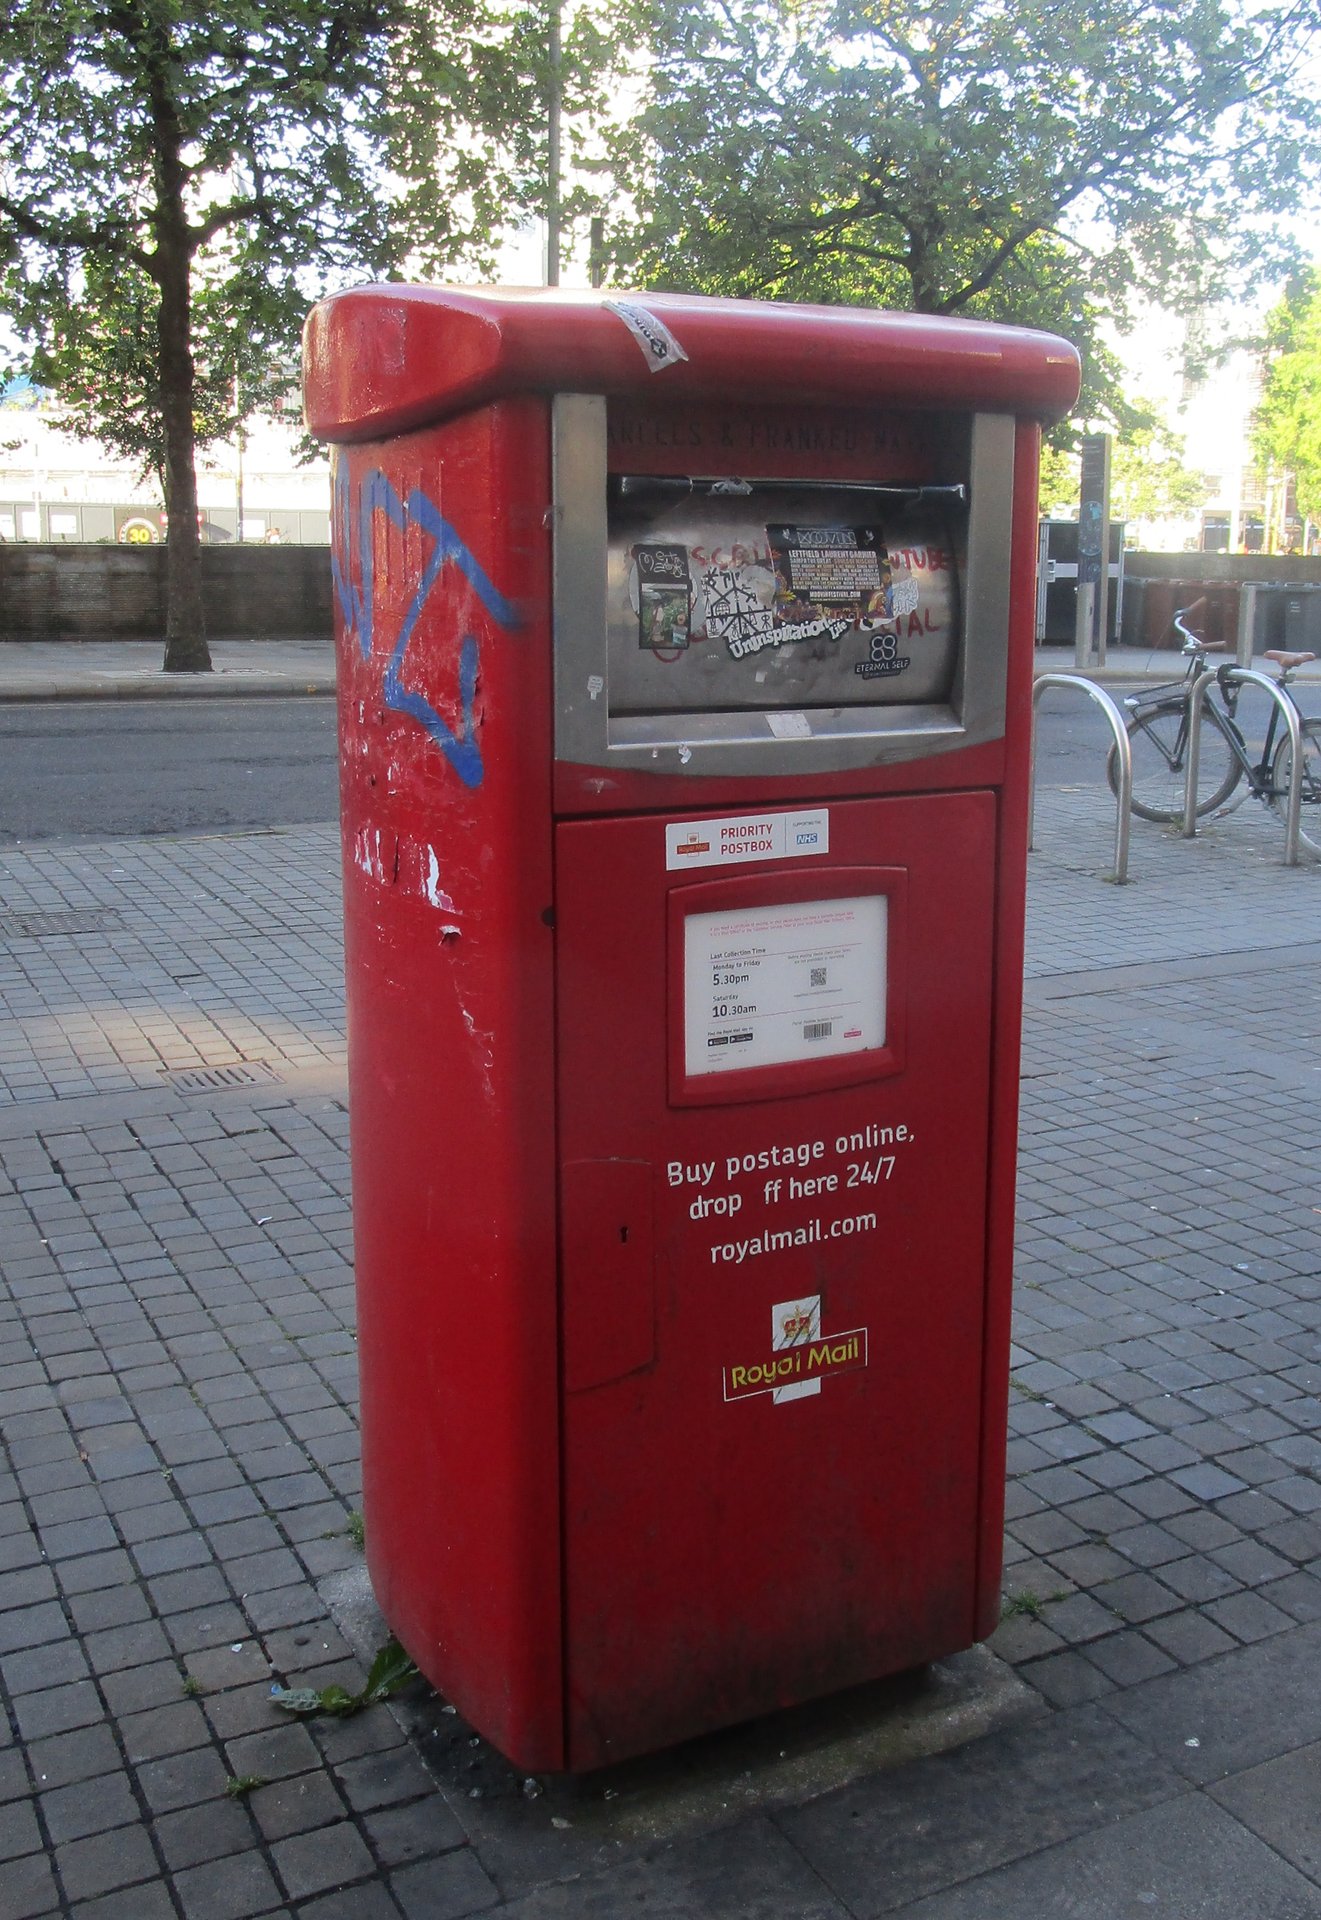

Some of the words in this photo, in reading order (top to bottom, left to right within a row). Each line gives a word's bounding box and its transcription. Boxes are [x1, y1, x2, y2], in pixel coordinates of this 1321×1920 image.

[129, 528, 150, 543] 30
[788, 550, 819, 559] LEFTFIELD
[821, 550, 848, 559] LAURENT
[829, 621, 848, 640] Life
[856, 662, 890, 673] ETERNAL
[891, 659, 909, 669] SELF
[720, 823, 774, 840] PRIORITY
[797, 833, 817, 845] NHS
[720, 839, 774, 856] POSTBOX
[723, 949, 751, 958] Collection
[752, 947, 766, 955] Time
[712, 963, 735, 971] Monday
[743, 959, 761, 967] Friday
[712, 972, 750, 986] 5.30pm
[712, 994, 739, 1003] Saturday
[712, 1004, 757, 1018] 10.30am
[667, 1160, 716, 1187] Buy
[726, 1140, 825, 1181] postage
[835, 1123, 916, 1154] online,
[688, 1193, 743, 1220] drop
[788, 1173, 839, 1200] here
[846, 1155, 896, 1188] 24/7
[710, 1211, 878, 1265] royalmail.com
[731, 1351, 801, 1390] Royal
[807, 1336, 859, 1370] Mail
